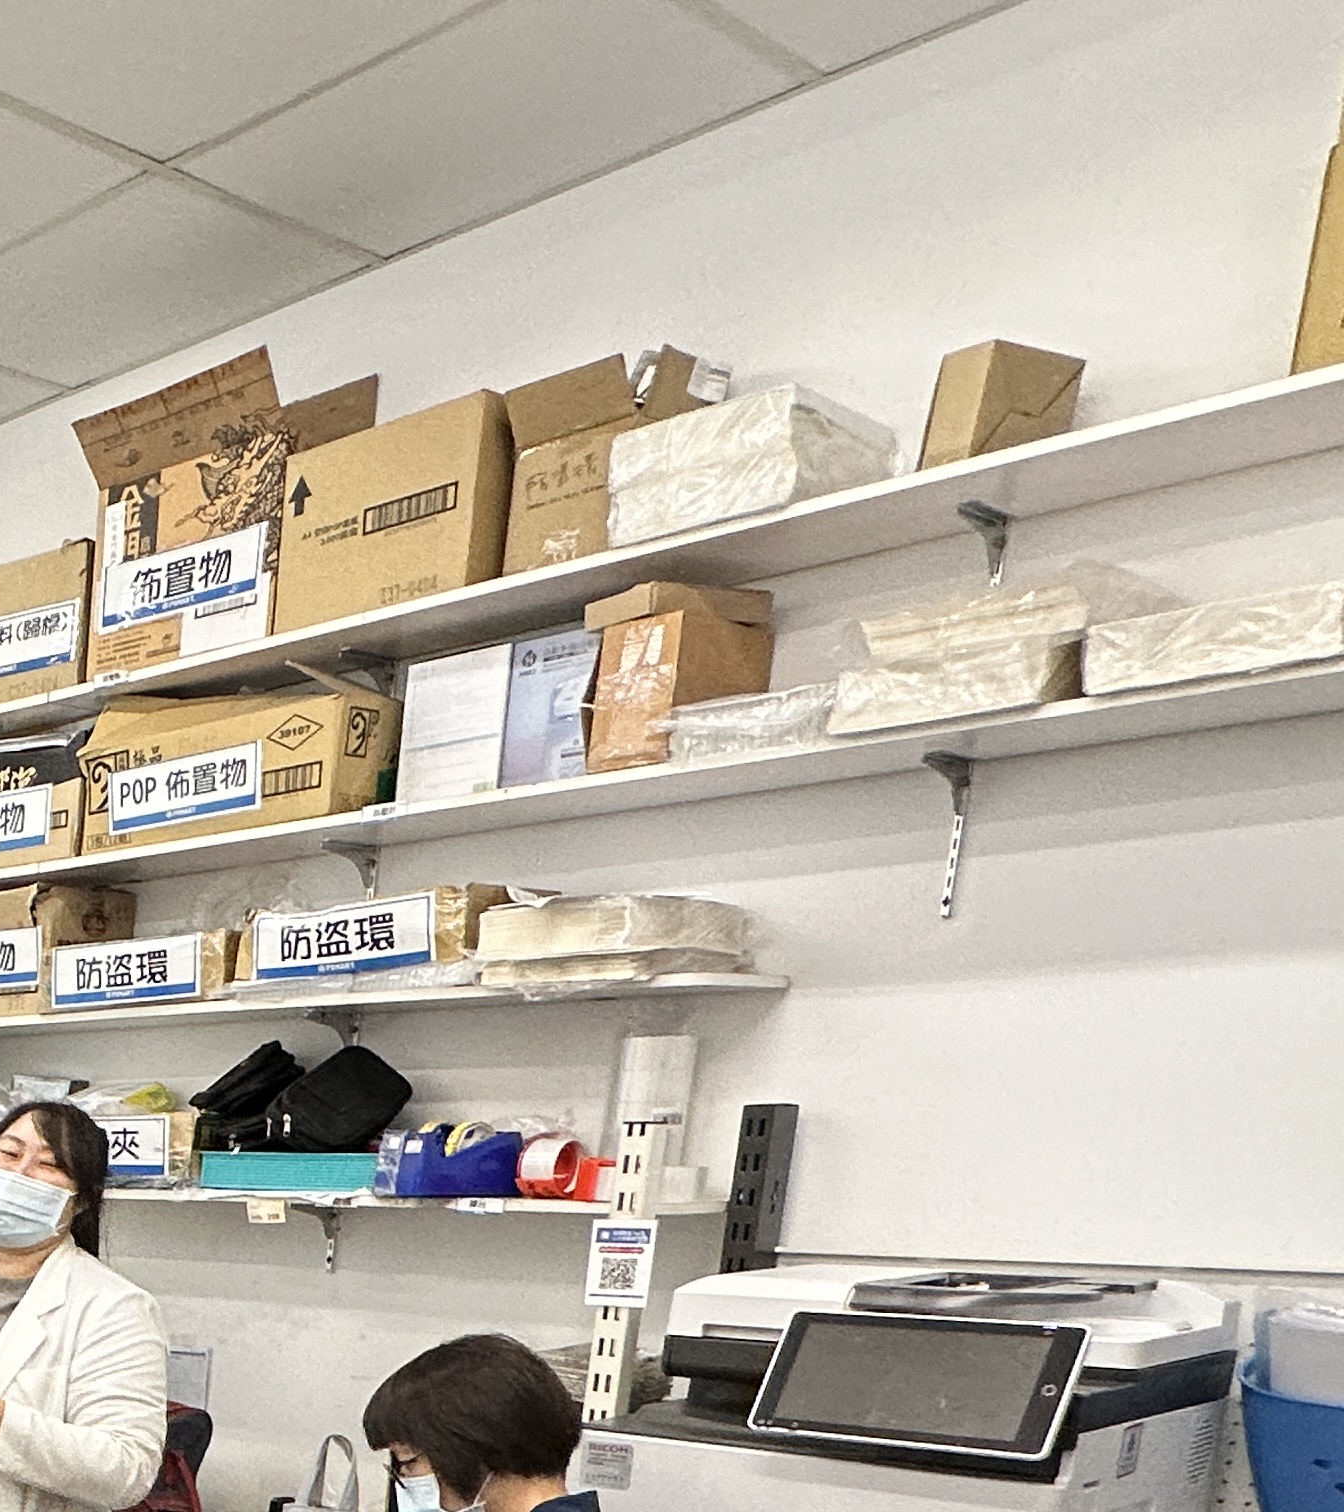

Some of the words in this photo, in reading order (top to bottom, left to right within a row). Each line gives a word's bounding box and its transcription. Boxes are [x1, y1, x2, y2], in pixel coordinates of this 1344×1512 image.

[129, 547, 233, 606] 佈置物
[119, 776, 157, 808] POP
[165, 758, 248, 801] 佈置物
[279, 912, 396, 962] 防盜環
[75, 949, 168, 991] 防盜環
[588, 1441, 629, 1454] RICOH
